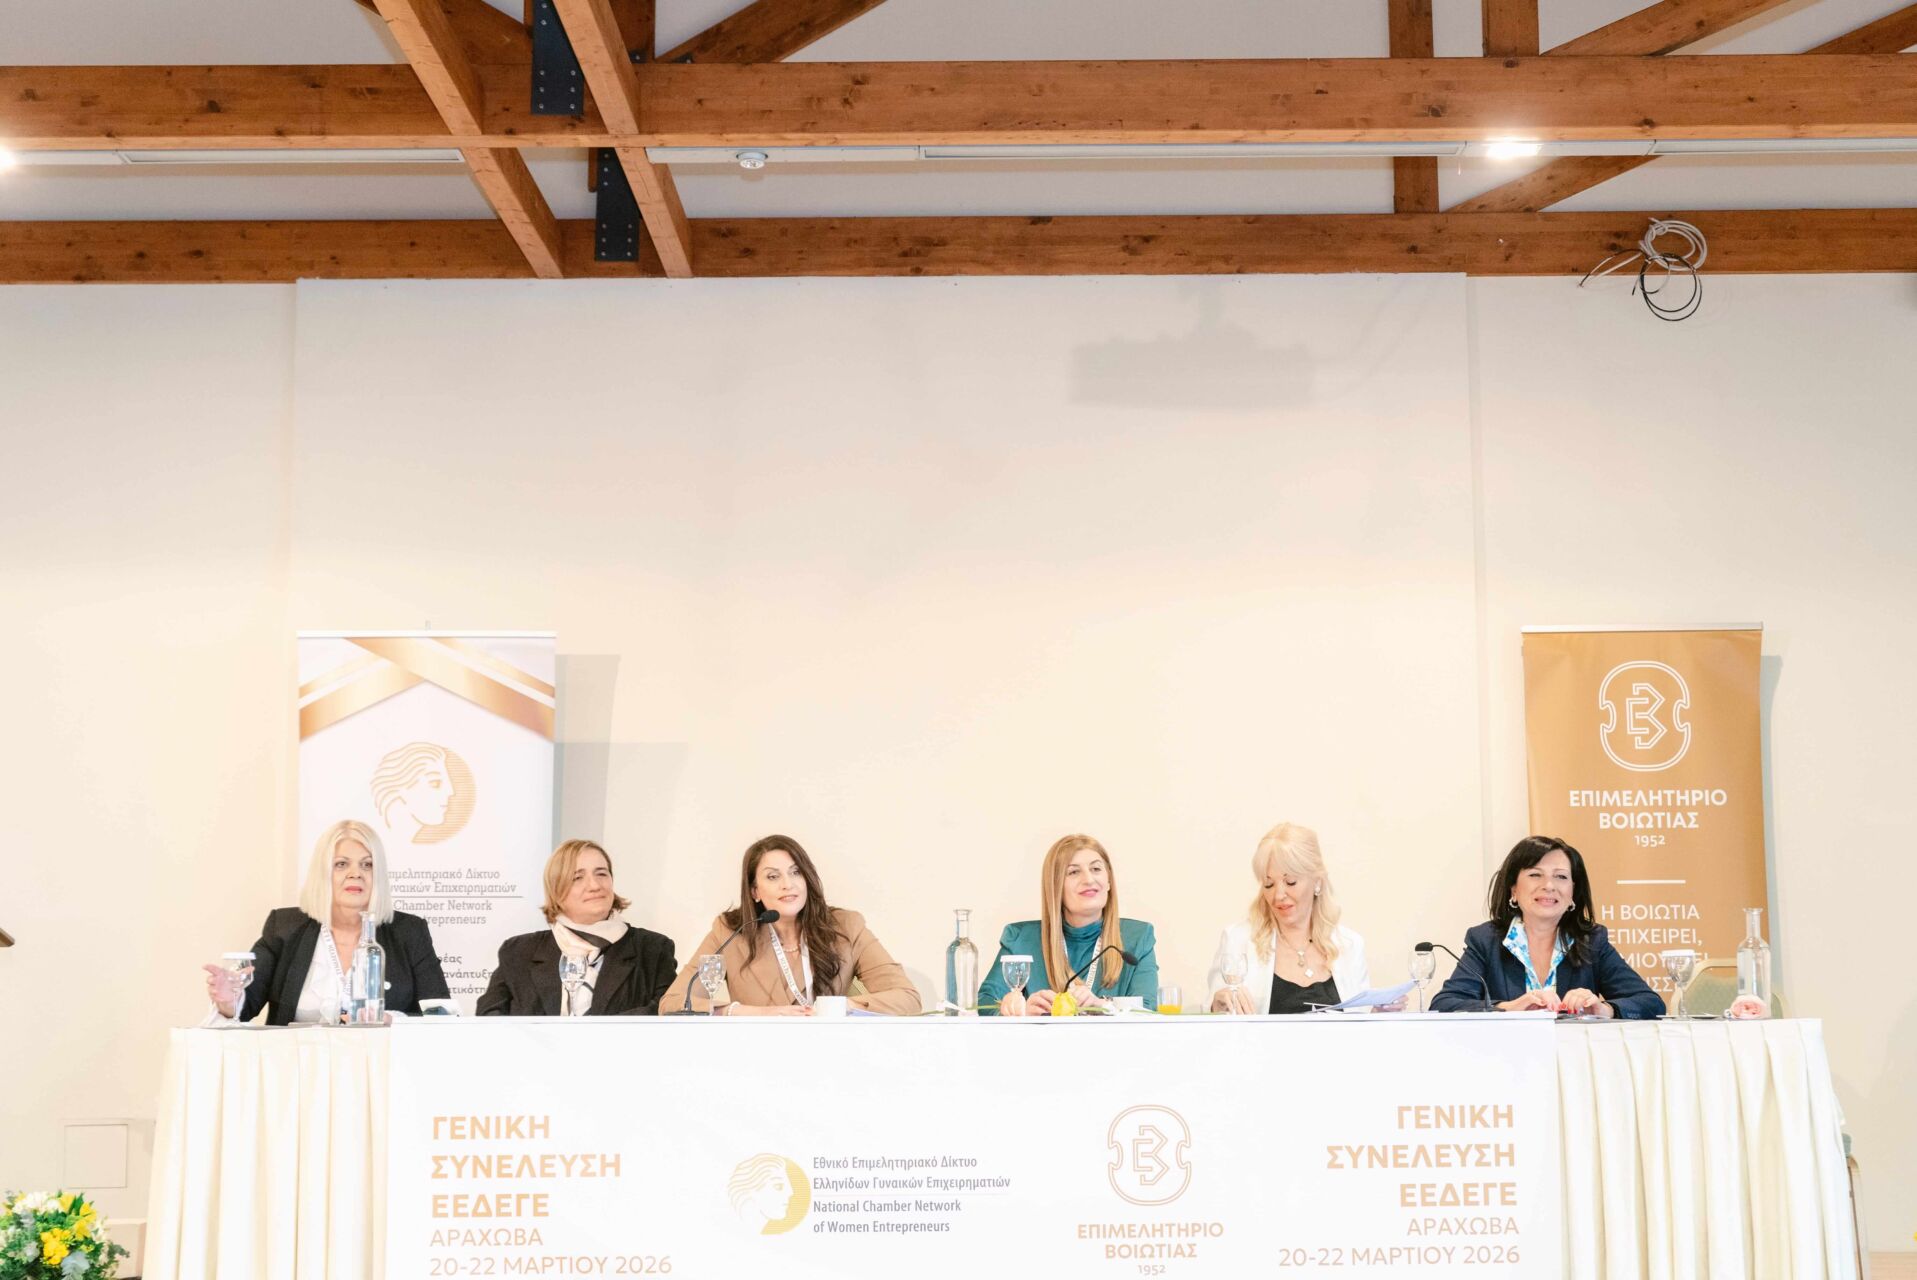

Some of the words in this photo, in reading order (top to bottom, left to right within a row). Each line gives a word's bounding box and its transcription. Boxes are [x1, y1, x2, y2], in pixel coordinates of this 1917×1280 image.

[1569, 789, 1728, 807] ΕΠΙΜΕΛΗΤΗΡΙΟ
[1599, 812, 1699, 829] ΒΟΙΩΤΙΑΣ
[1635, 835, 1665, 847] 1952
[466, 868, 500, 879] Δίκτυο
[434, 882, 517, 895] Επιχειρηματιών
[394, 900, 445, 911] Chamber
[448, 900, 493, 911] Network
[1602, 905, 1614, 920] Η
[1621, 905, 1699, 920] ΒΟΙΩΤΙΑ
[1398, 1105, 1513, 1129] ΓΕΝΙΚΗ
[433, 1116, 549, 1139] ΓΕΝΙΚΗ
[814, 1157, 848, 1168] Εθνικό
[853, 1156, 937, 1170] Επιμελητηριακό
[941, 1156, 977, 1167] Δίκτυο
[1327, 1144, 1514, 1168] ΣΥΝΕΛΕΥΣΗ
[432, 1154, 620, 1179] ΣΥΝΕΛΕΥΣΗ
[814, 1177, 869, 1192] Ελληνίδων
[874, 1177, 923, 1188] Γυναικών
[927, 1176, 1010, 1190] Επιχειρηματιών
[1400, 1182, 1517, 1207] ΕΕΔΕΓΕ
[433, 1194, 549, 1217] ΕΕΔΕΓΕ
[814, 1200, 859, 1212] National
[863, 1200, 911, 1211] Chamber
[915, 1200, 960, 1211] Network
[814, 1221, 824, 1232] of
[828, 1221, 869, 1232] Women
[873, 1221, 949, 1235] Entrepreneurs
[1078, 1223, 1223, 1239] ΕΠΙΜΕΛΗΤΗΡΙΟ
[1407, 1217, 1519, 1235] ΑΡΑΧΩΒΑ
[430, 1228, 543, 1246] ΑΡΑΧΩΒΑ
[1106, 1243, 1197, 1259] ΒΟΙΩΤΙΑΣ
[1279, 1248, 1343, 1266] 20-22
[1352, 1247, 1455, 1265] ΜΑΡΤΙΟΥ
[1464, 1246, 1519, 1264] 2026
[430, 1257, 495, 1276] 20-22
[504, 1256, 608, 1274] ΜΑΡΤΙΟΥ
[616, 1256, 671, 1274] 2026
[1138, 1265, 1166, 1276] 1952
